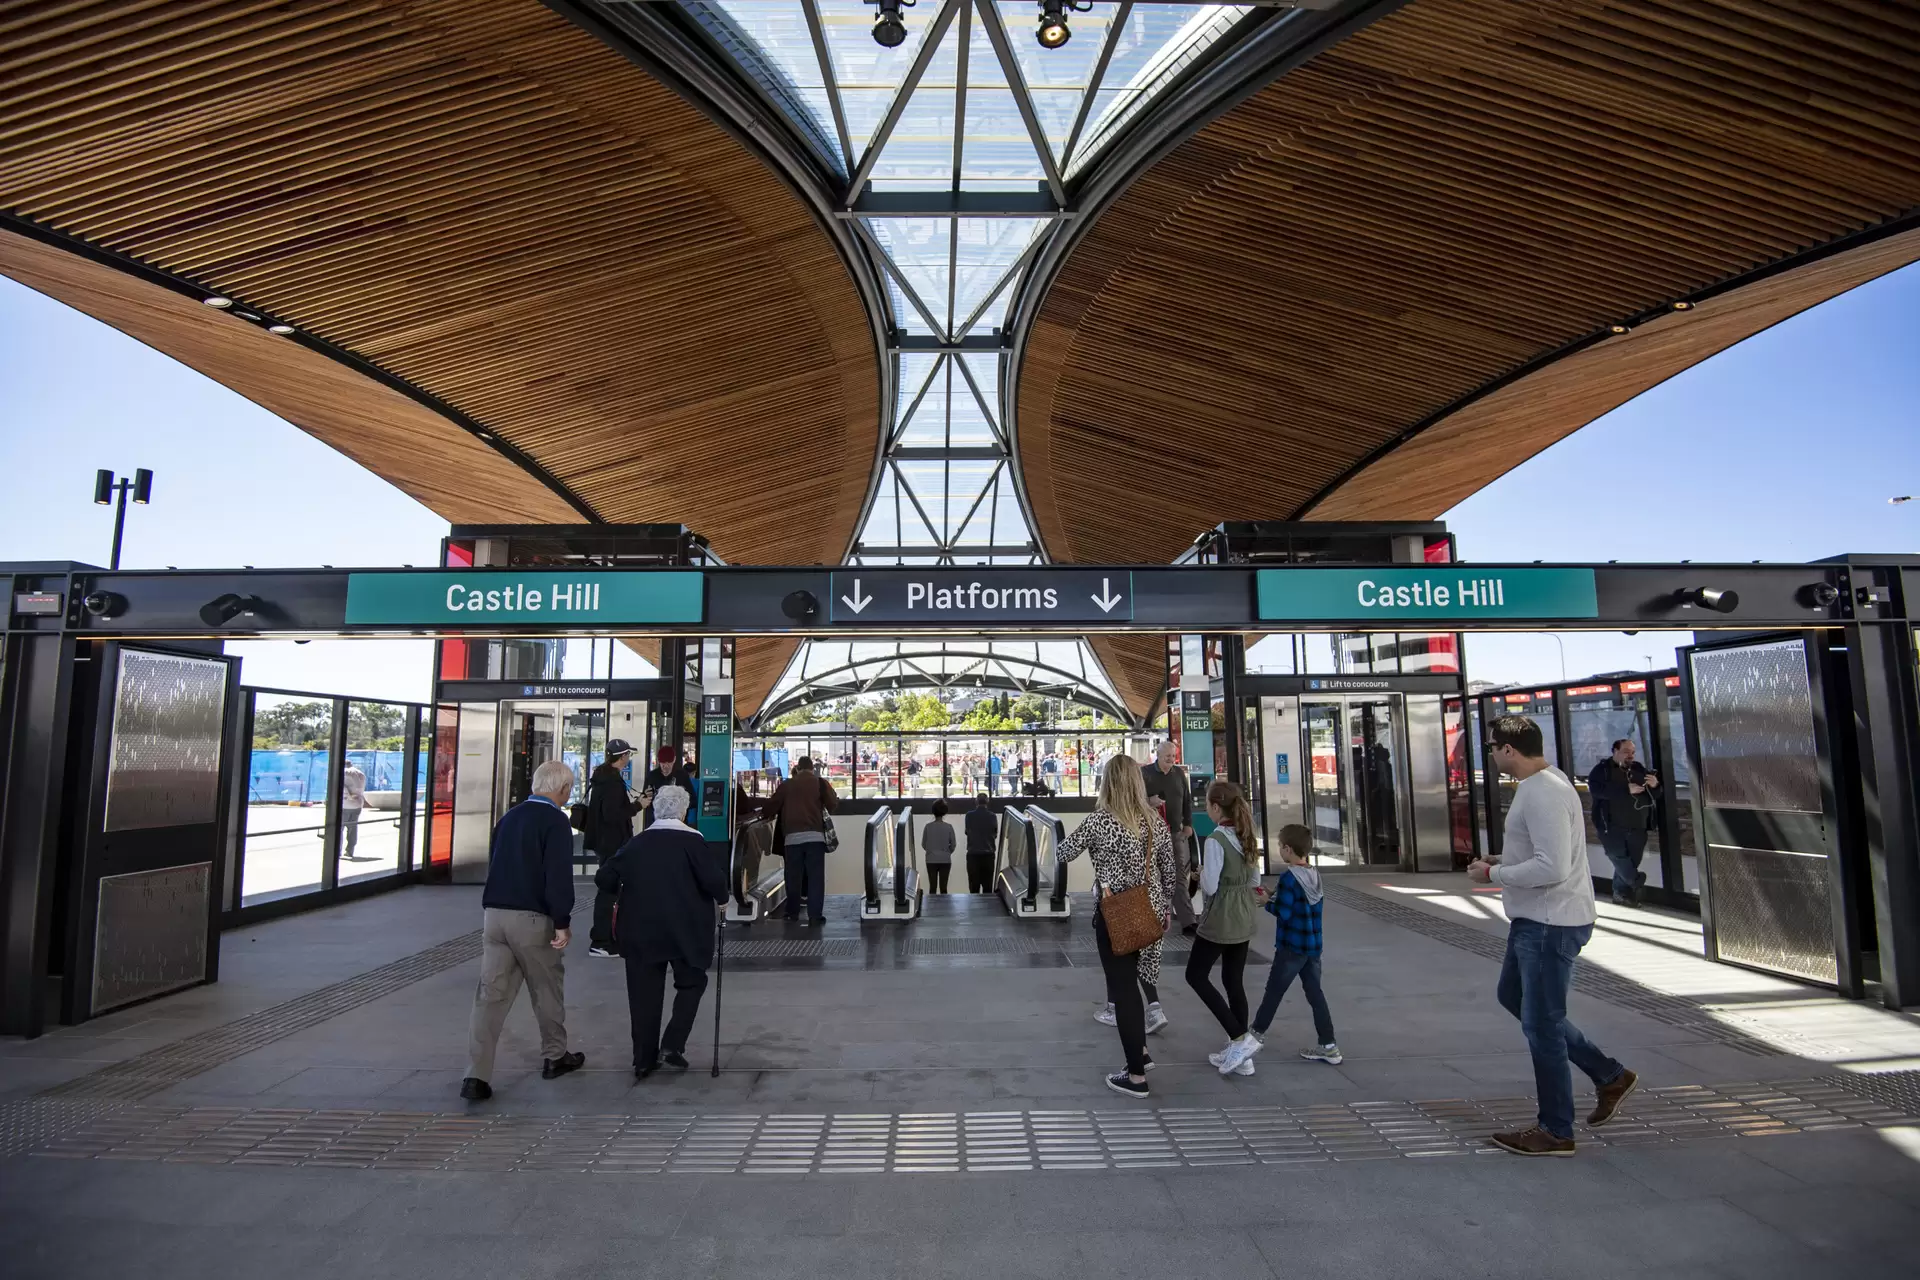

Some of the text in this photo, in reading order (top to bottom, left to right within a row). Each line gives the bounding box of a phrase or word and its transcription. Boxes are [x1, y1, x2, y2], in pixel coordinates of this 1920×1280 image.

[446, 583, 600, 611] Castle Hill
[907, 581, 1058, 610] Platforms
[1357, 579, 1504, 607] Castle Hill
[1330, 680, 1342, 688] Lift
[1343, 680, 1351, 688] to
[544, 686, 557, 694] Lift
[558, 686, 567, 694] to
[704, 724, 728, 734] HELP
[1186, 720, 1209, 730] HELP
